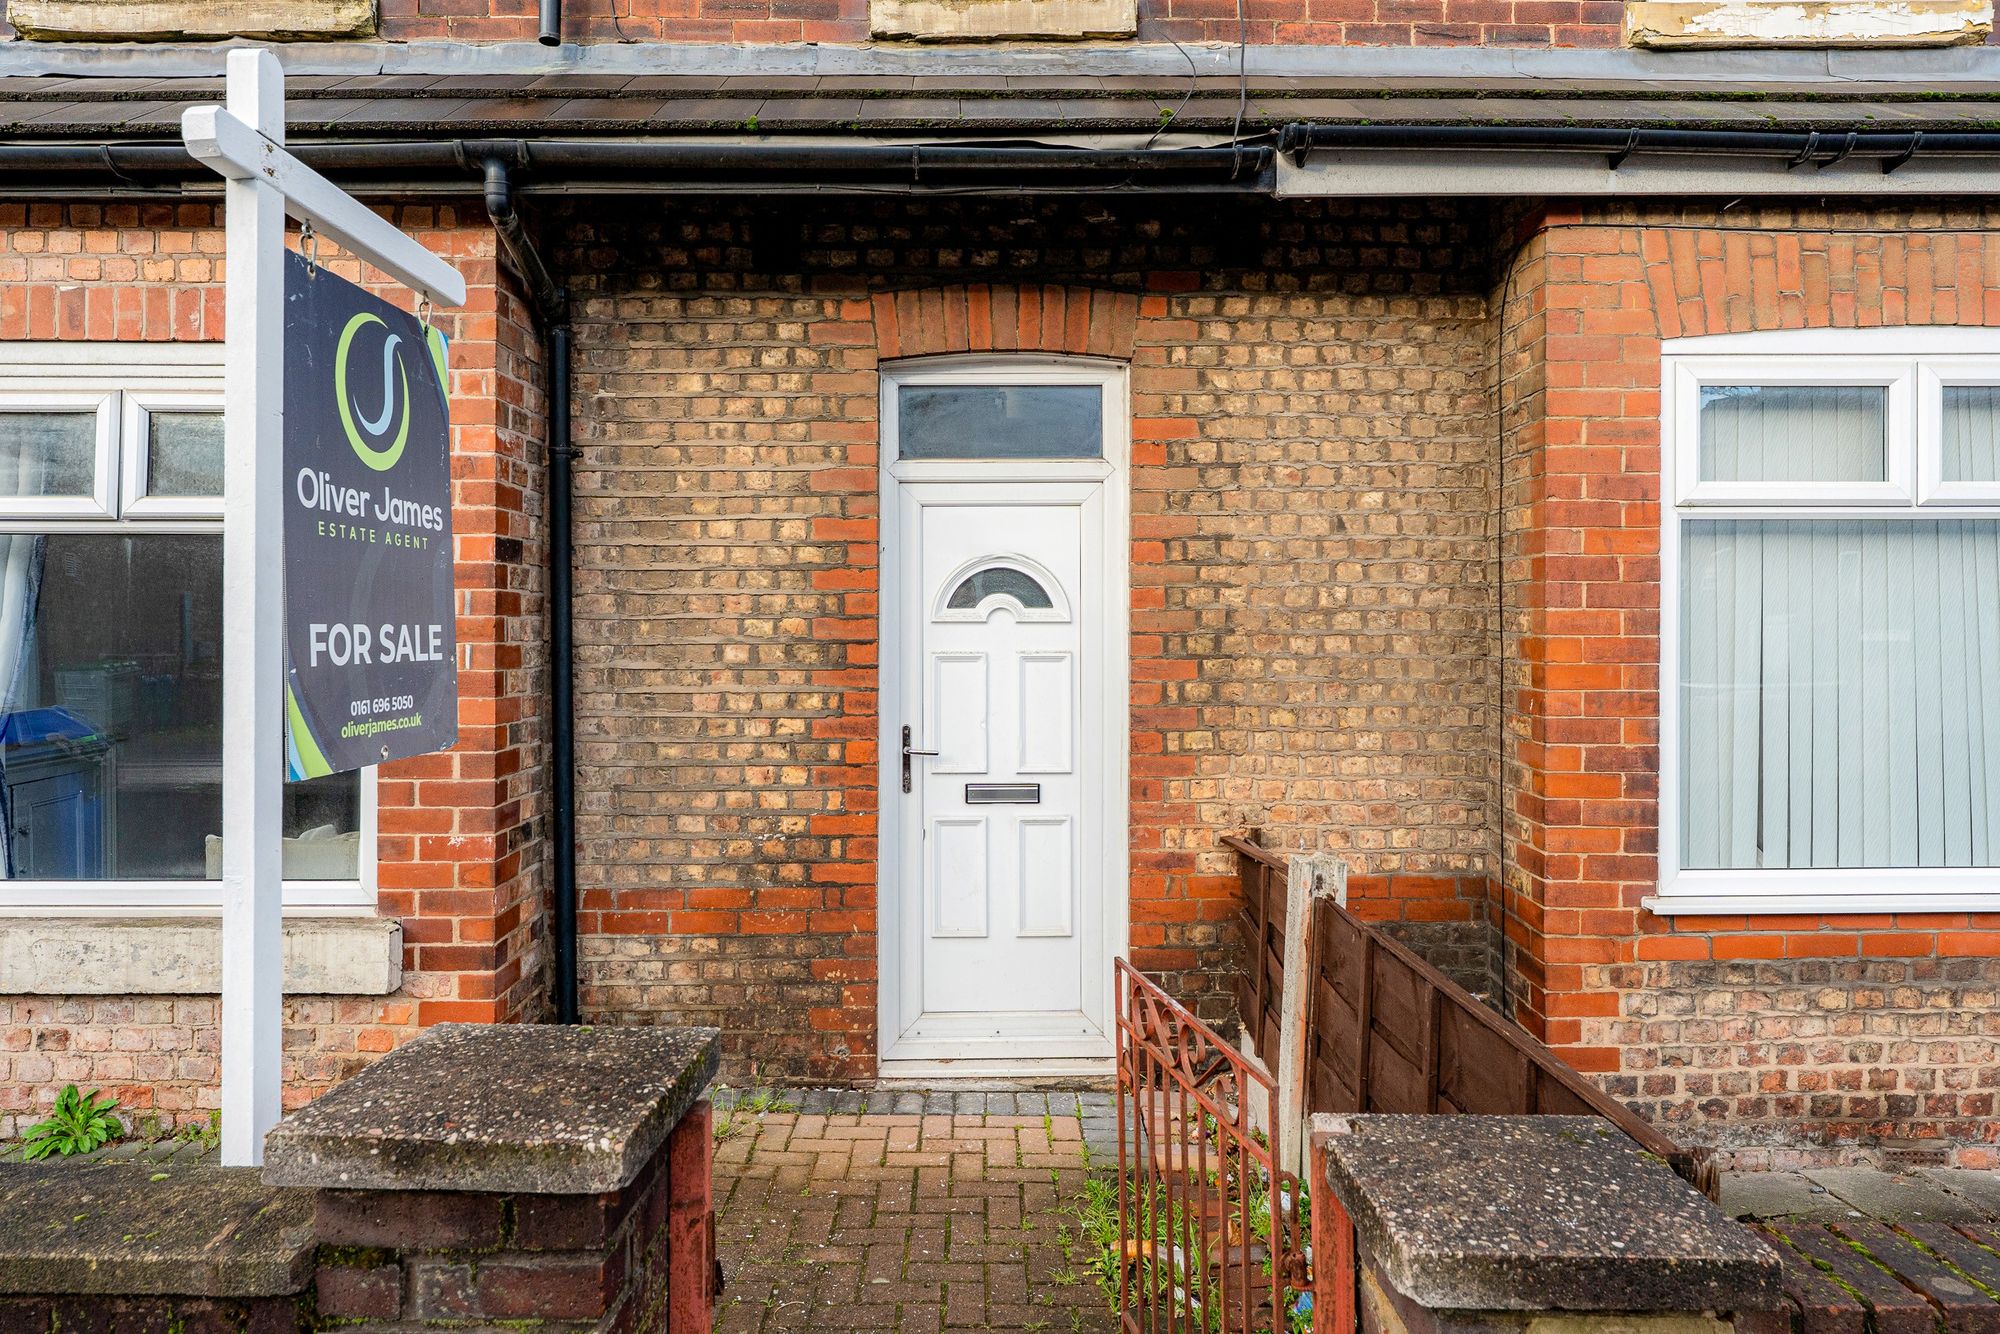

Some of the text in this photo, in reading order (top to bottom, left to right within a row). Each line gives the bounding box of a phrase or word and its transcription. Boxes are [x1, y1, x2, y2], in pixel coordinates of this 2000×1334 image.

[297, 467, 443, 531] Oliver James
[318, 521, 428, 549] ESTATE AGENT
[309, 623, 443, 667] FOR SALE
[351, 694, 414, 716] 0161 696 5050
[341, 711, 422, 739] oliverjames.co.uk
